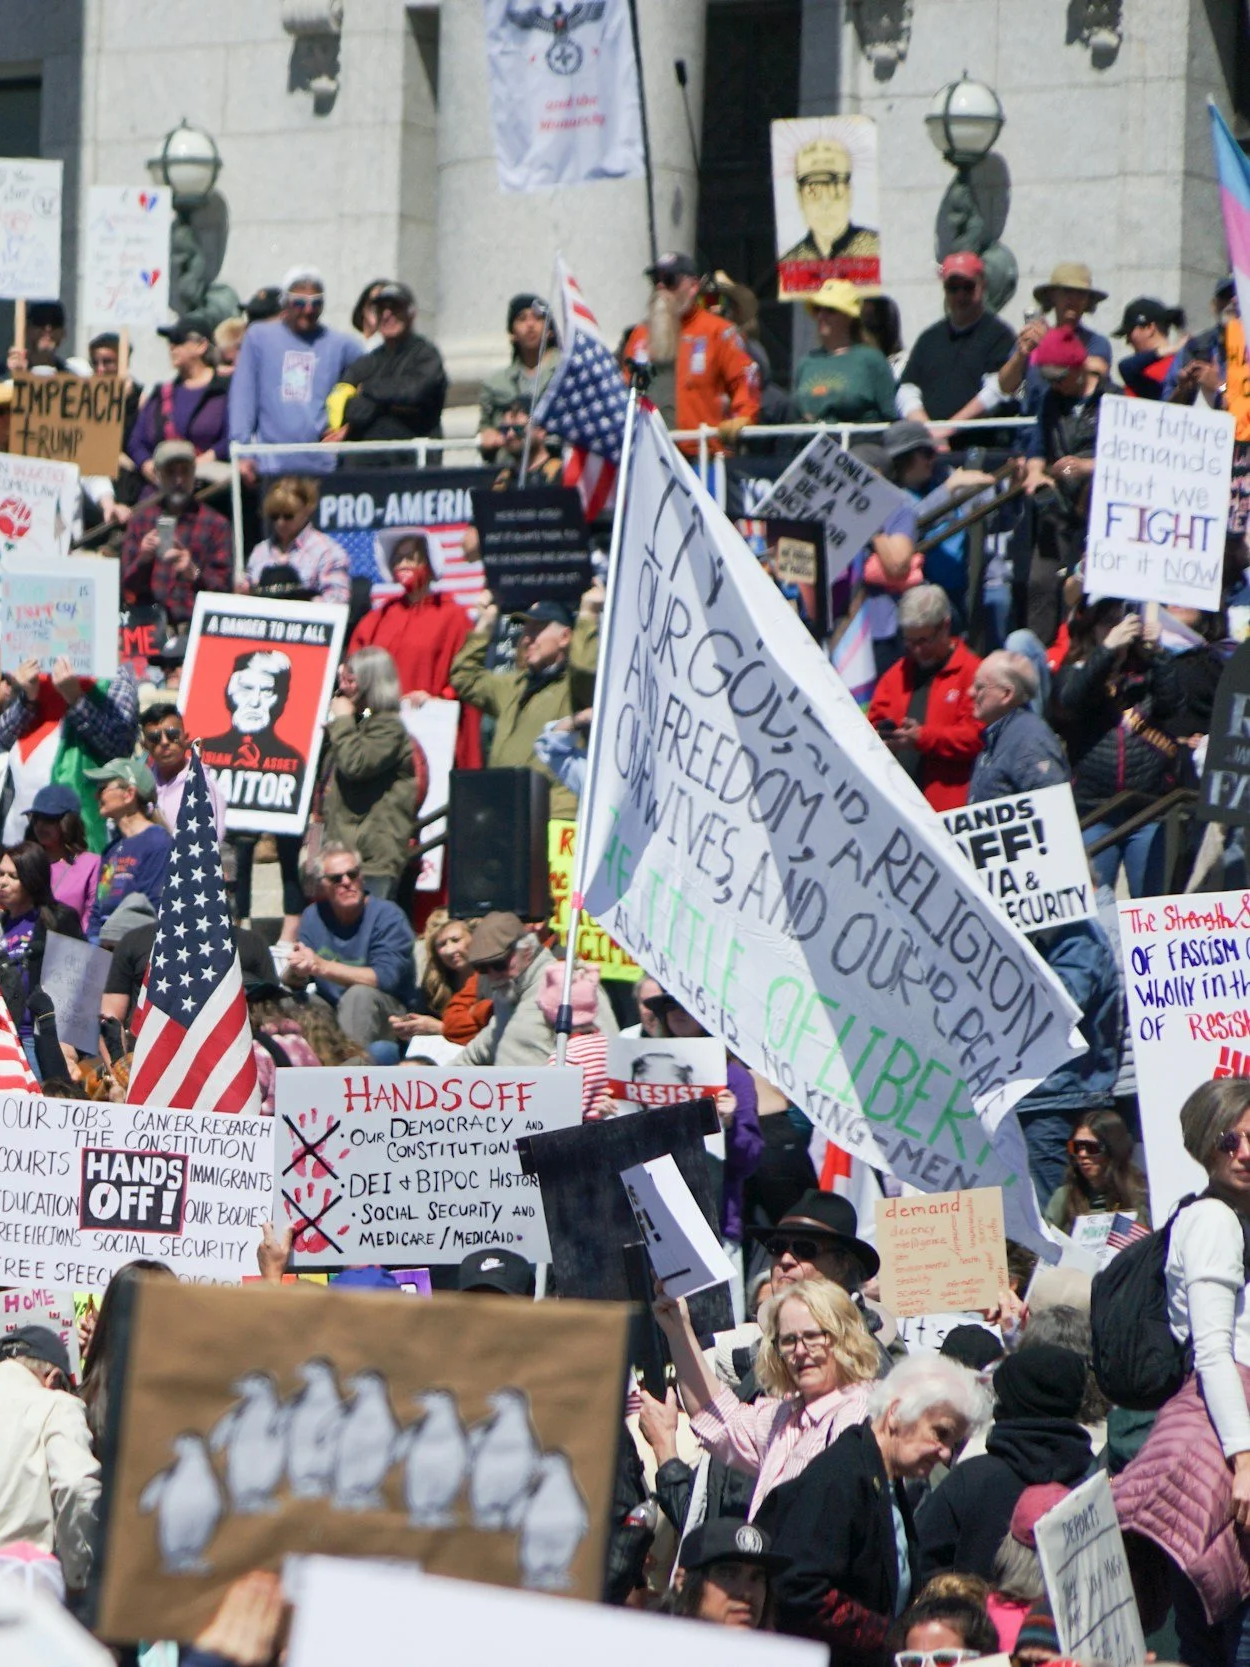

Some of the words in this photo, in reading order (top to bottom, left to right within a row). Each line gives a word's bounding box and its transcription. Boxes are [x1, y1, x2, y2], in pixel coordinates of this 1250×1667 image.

[12, 379, 125, 423] IMPEACH
[1112, 400, 1148, 432] The
[1157, 405, 1229, 450] future
[833, 452, 875, 487] ONLY
[1101, 436, 1223, 476] demands
[1102, 466, 1156, 501] that
[1171, 484, 1210, 510] we
[1105, 501, 1219, 552] FIGHT
[1092, 540, 1129, 572] for
[1137, 552, 1154, 575] it
[1163, 555, 1220, 586] NOW
[207, 615, 219, 633] A
[220, 616, 269, 637] DANGER
[271, 620, 283, 638] TO
[286, 624, 302, 640] US
[303, 625, 328, 642] ALL
[657, 694, 826, 864] FREEDOM,
[956, 818, 1049, 871] FF!
[738, 852, 829, 944] AND
[1024, 870, 1041, 890] &
[998, 883, 1089, 927] ECURITY
[1119, 907, 1157, 934] The
[1164, 902, 1235, 932] Strength
[647, 867, 747, 1016] TITLE
[765, 974, 841, 1065] OF
[1131, 943, 1156, 976] OF
[1167, 934, 1240, 971] FASCISM
[613, 905, 671, 983] ALMA
[678, 970, 741, 1048] 46:12
[1202, 971, 1227, 999] in
[1139, 1013, 1167, 1042] OF
[760, 1040, 796, 1091] NO
[342, 1074, 463, 1113] HANDS
[468, 1079, 539, 1112] OFF
[624, 1082, 706, 1105] RESIST
[2, 1097, 52, 1130] OUR
[58, 1103, 113, 1130] JOBS
[132, 1108, 199, 1135] CANCER
[200, 1116, 273, 1138] RESEARCH
[350, 1128, 386, 1147] OUR
[390, 1115, 514, 1140] DEMOCRACY
[525, 1120, 544, 1132] AND
[73, 1129, 115, 1149] THE
[124, 1130, 256, 1163] CONSTITUTION
[386, 1138, 511, 1164] CONSTITUTION
[86, 1151, 184, 1191] HANDS
[189, 1163, 273, 1192] IMMIGRANTS
[350, 1171, 393, 1199] DEI
[416, 1168, 480, 1195] BIPOC
[489, 1166, 540, 1189] HISTOR
[88, 1182, 179, 1226] OFF!
[184, 1198, 213, 1226] OUR
[217, 1201, 270, 1229] BODIES
[361, 1202, 420, 1226] SOCIAL
[427, 1201, 504, 1225] SECURITY
[512, 1204, 536, 1218] AND
[885, 1191, 961, 1220] demand
[24, 1223, 82, 1248] ELECTIONS
[93, 1231, 154, 1257] SOCIAL
[159, 1236, 250, 1263] SECURITY
[359, 1231, 435, 1247] MEDICARE
[453, 1230, 515, 1246] MEDICAID
[890, 1224, 936, 1238] decency
[3, 1288, 56, 1314] HOME
[897, 1287, 932, 1298] science
